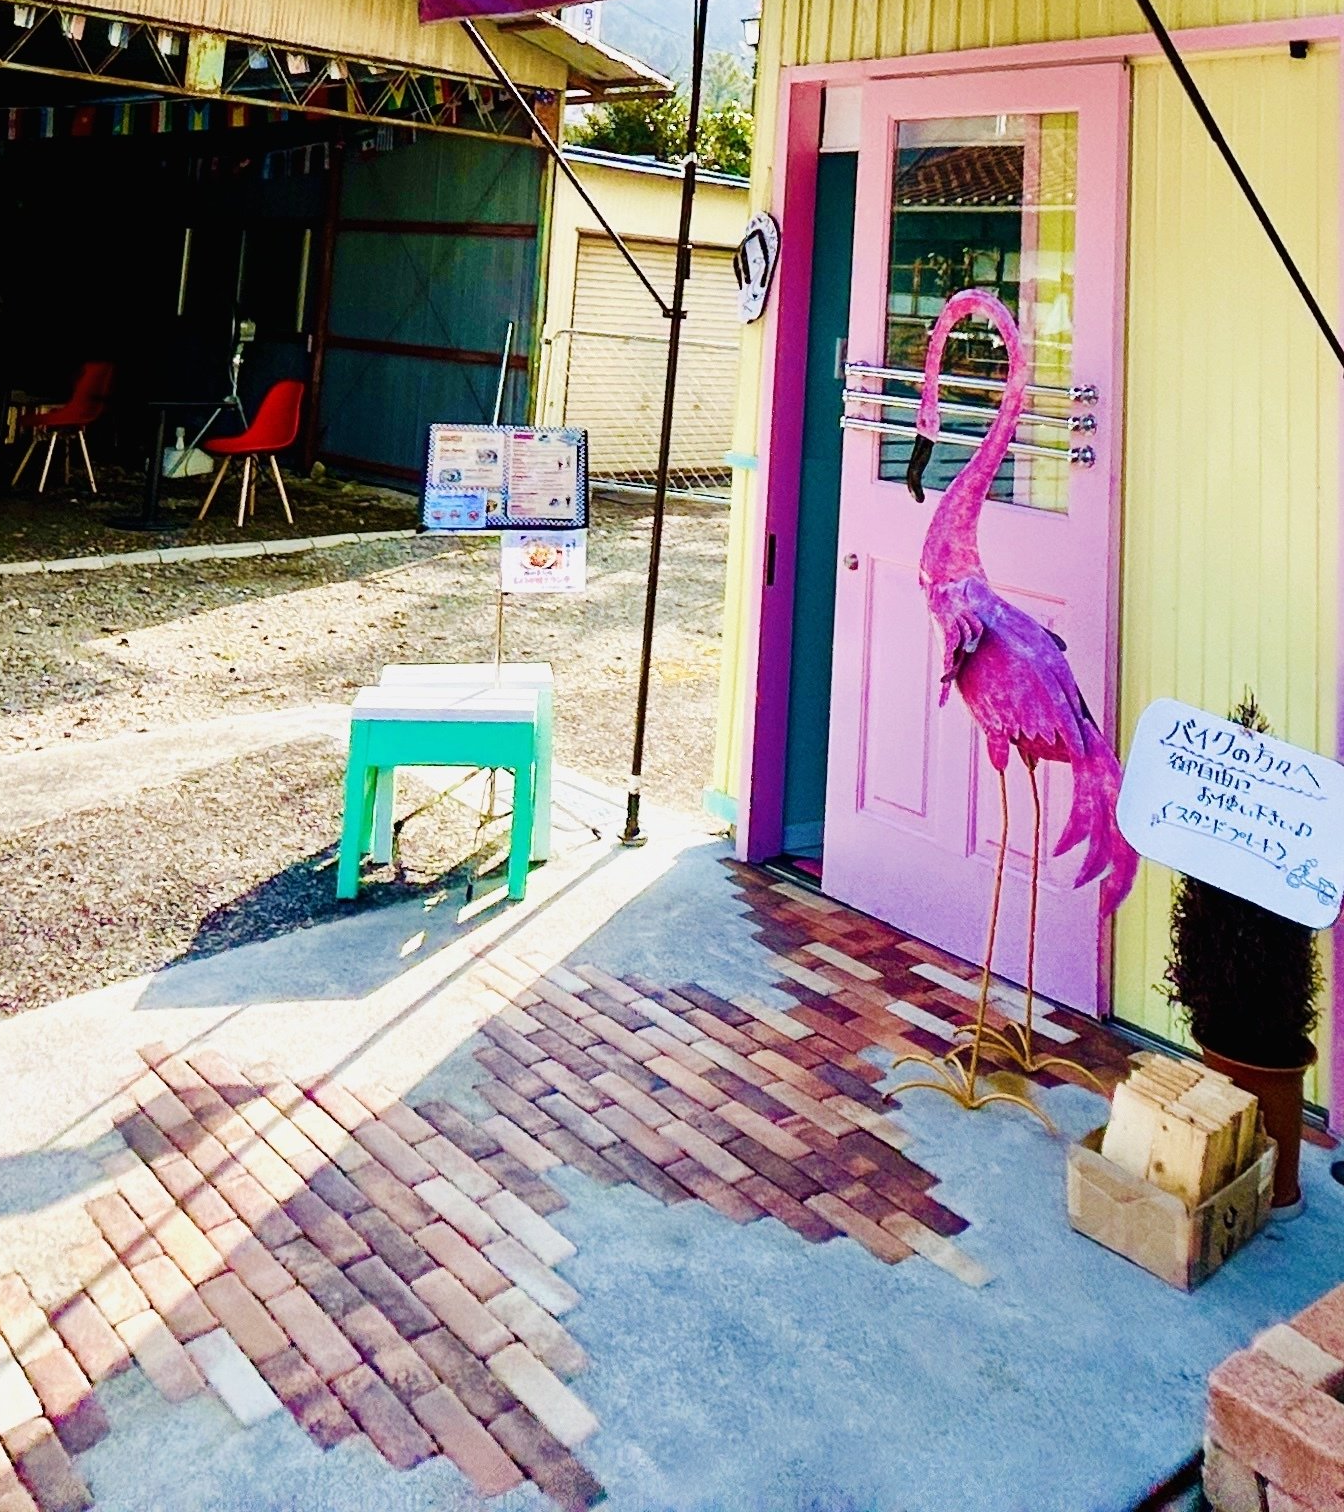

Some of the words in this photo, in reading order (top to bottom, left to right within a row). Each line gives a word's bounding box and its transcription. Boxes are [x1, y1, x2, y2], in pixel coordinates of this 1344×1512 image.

[1165, 718, 1321, 789] バイクの方々へ
[1168, 752, 1251, 794] 御自由に
